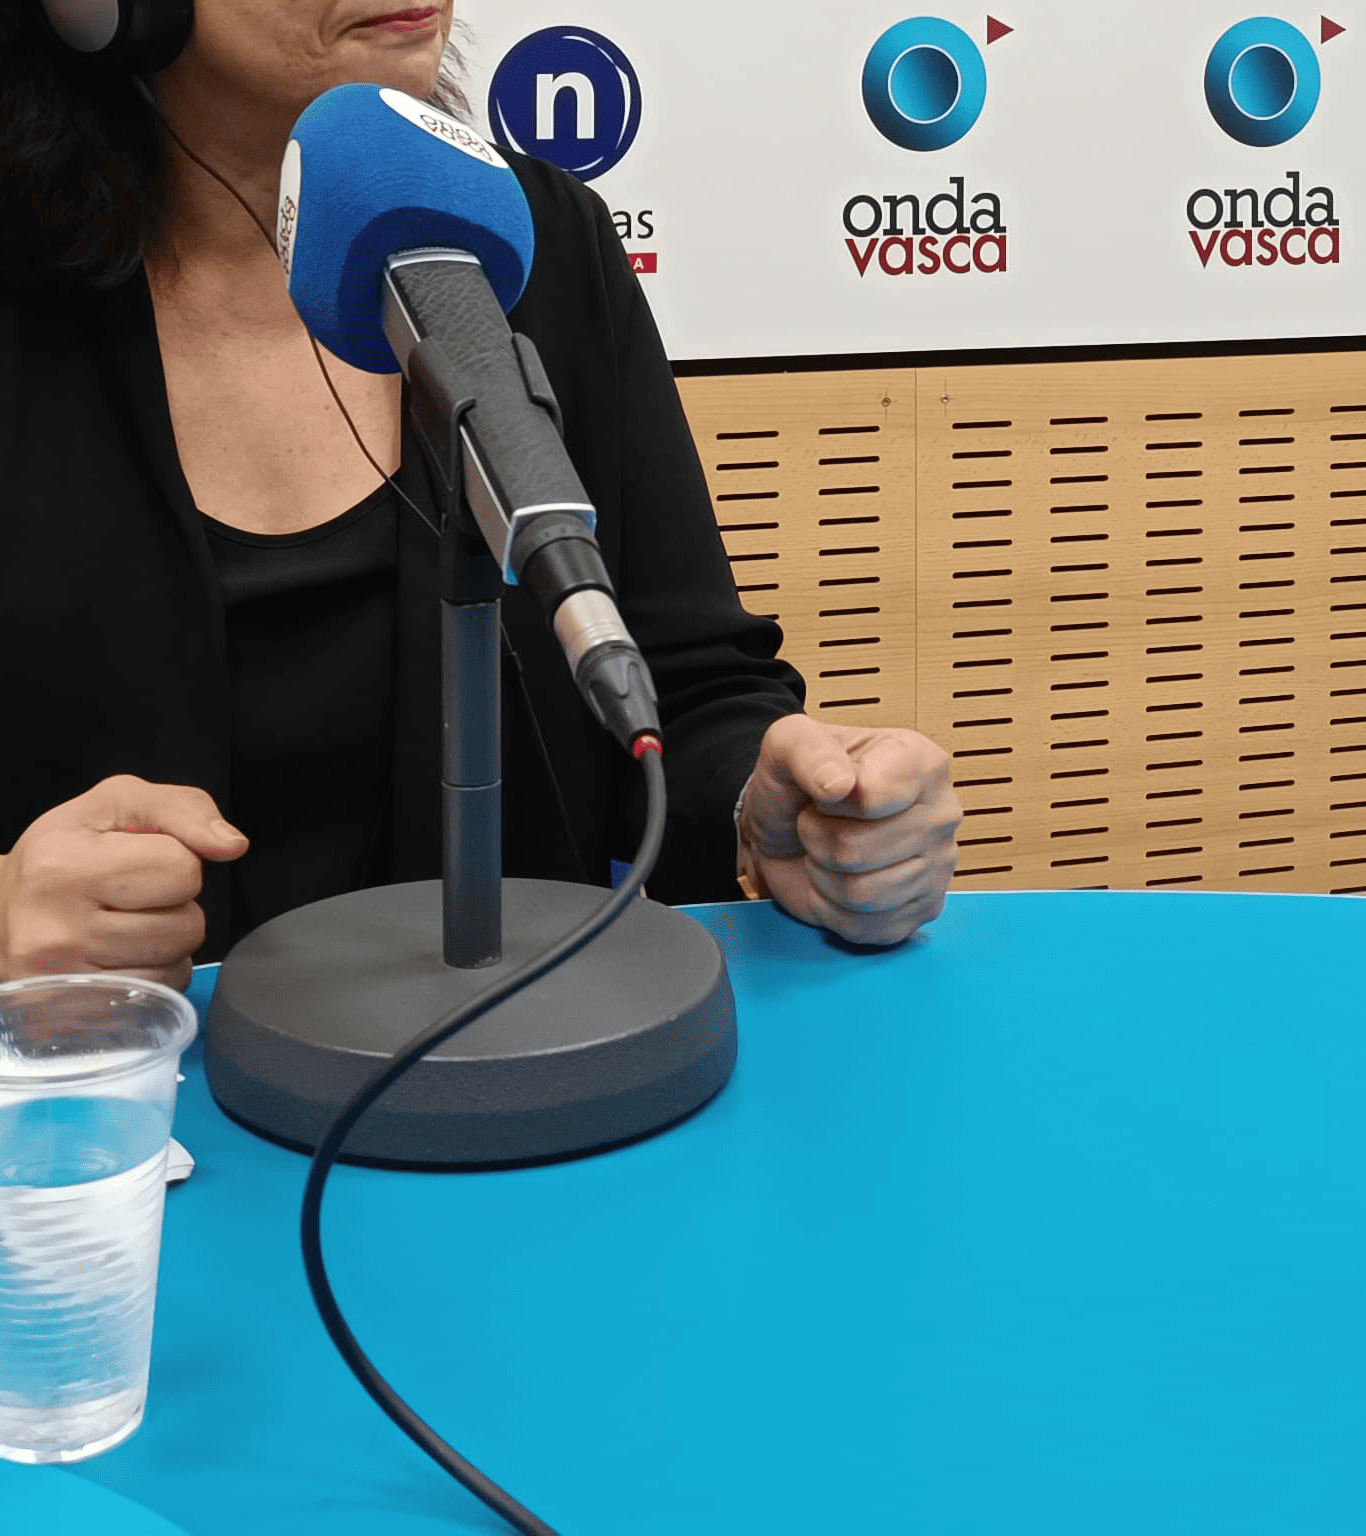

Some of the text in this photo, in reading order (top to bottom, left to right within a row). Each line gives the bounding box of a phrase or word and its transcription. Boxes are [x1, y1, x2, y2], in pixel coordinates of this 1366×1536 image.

[534, 70, 596, 142] n
[842, 176, 1007, 238] onda
[1186, 171, 1340, 230] onda
[844, 232, 1007, 278] vasca
[1188, 225, 1340, 269] vasca
